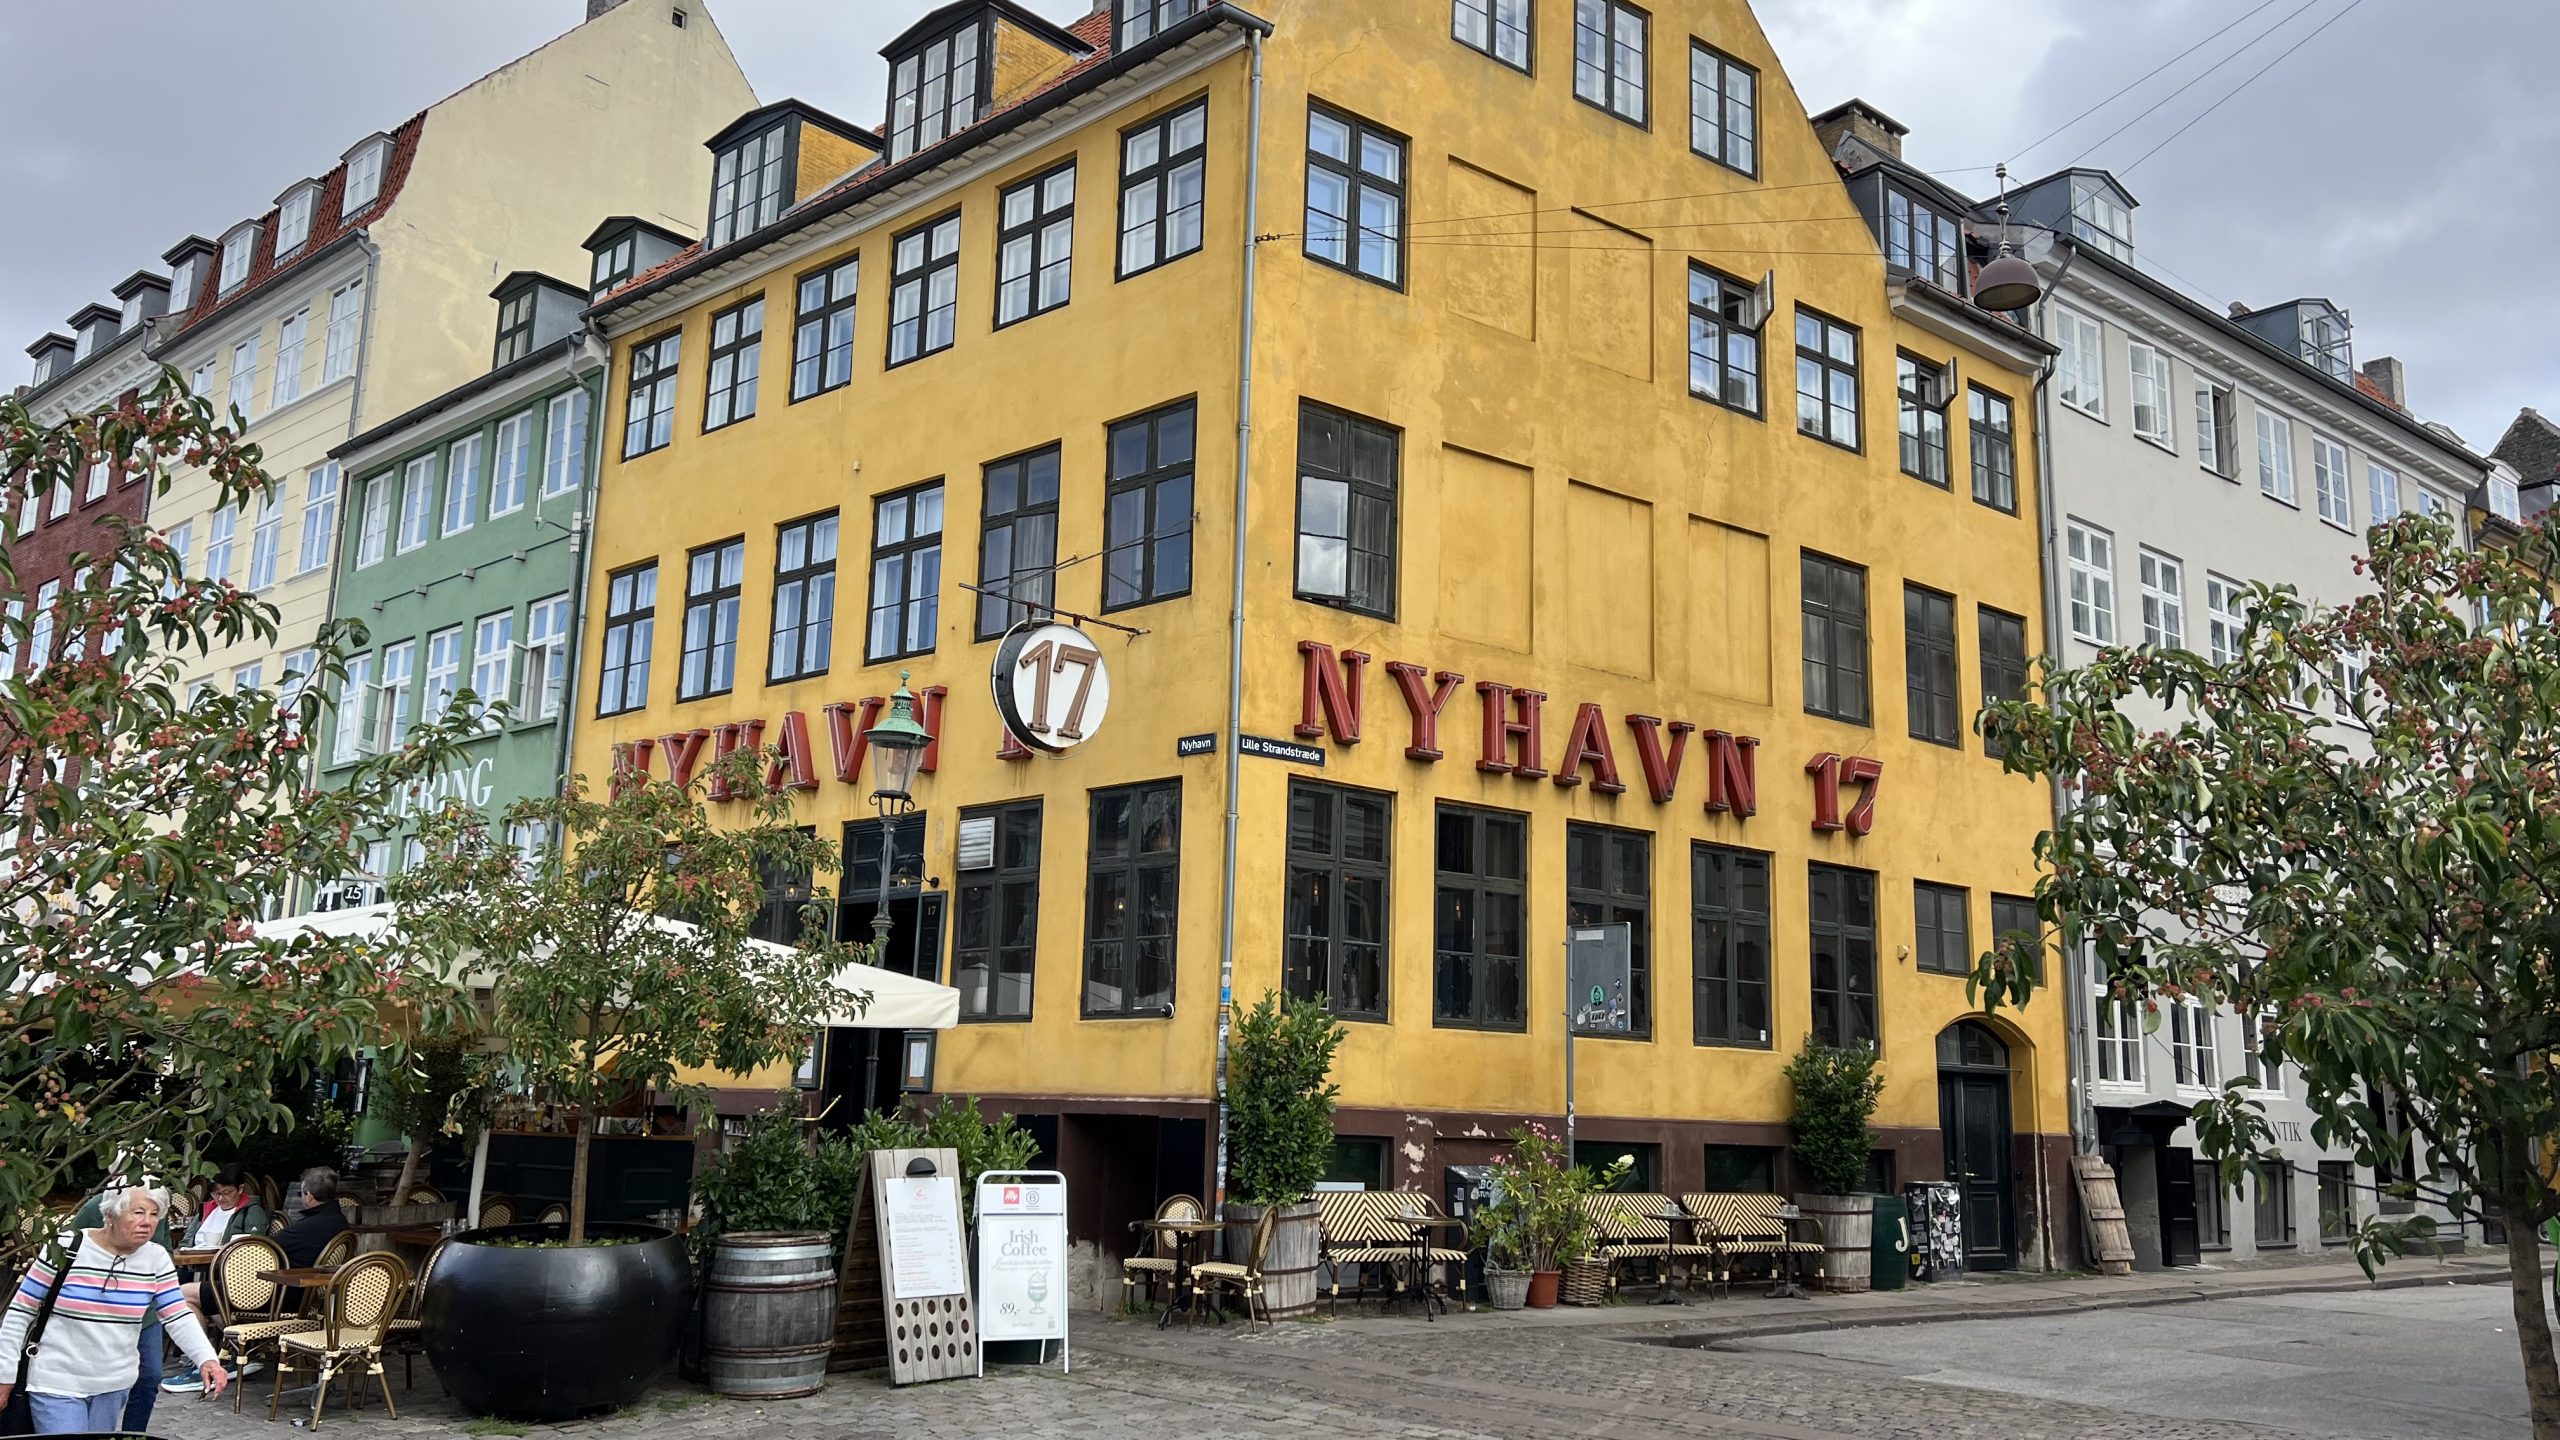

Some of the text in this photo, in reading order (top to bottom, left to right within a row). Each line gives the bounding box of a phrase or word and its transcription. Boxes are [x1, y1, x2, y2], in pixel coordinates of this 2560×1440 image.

[1018, 640, 1101, 739] 17
[1181, 738, 1211, 752] Nyhavn
[1293, 639, 1884, 838] NYHAVN 17
[1241, 738, 1320, 761] Lille Strandstræde
[345, 886, 362, 900] 15
[1009, 1229, 1039, 1243] Irish
[1001, 1242, 1047, 1257] Coffee
